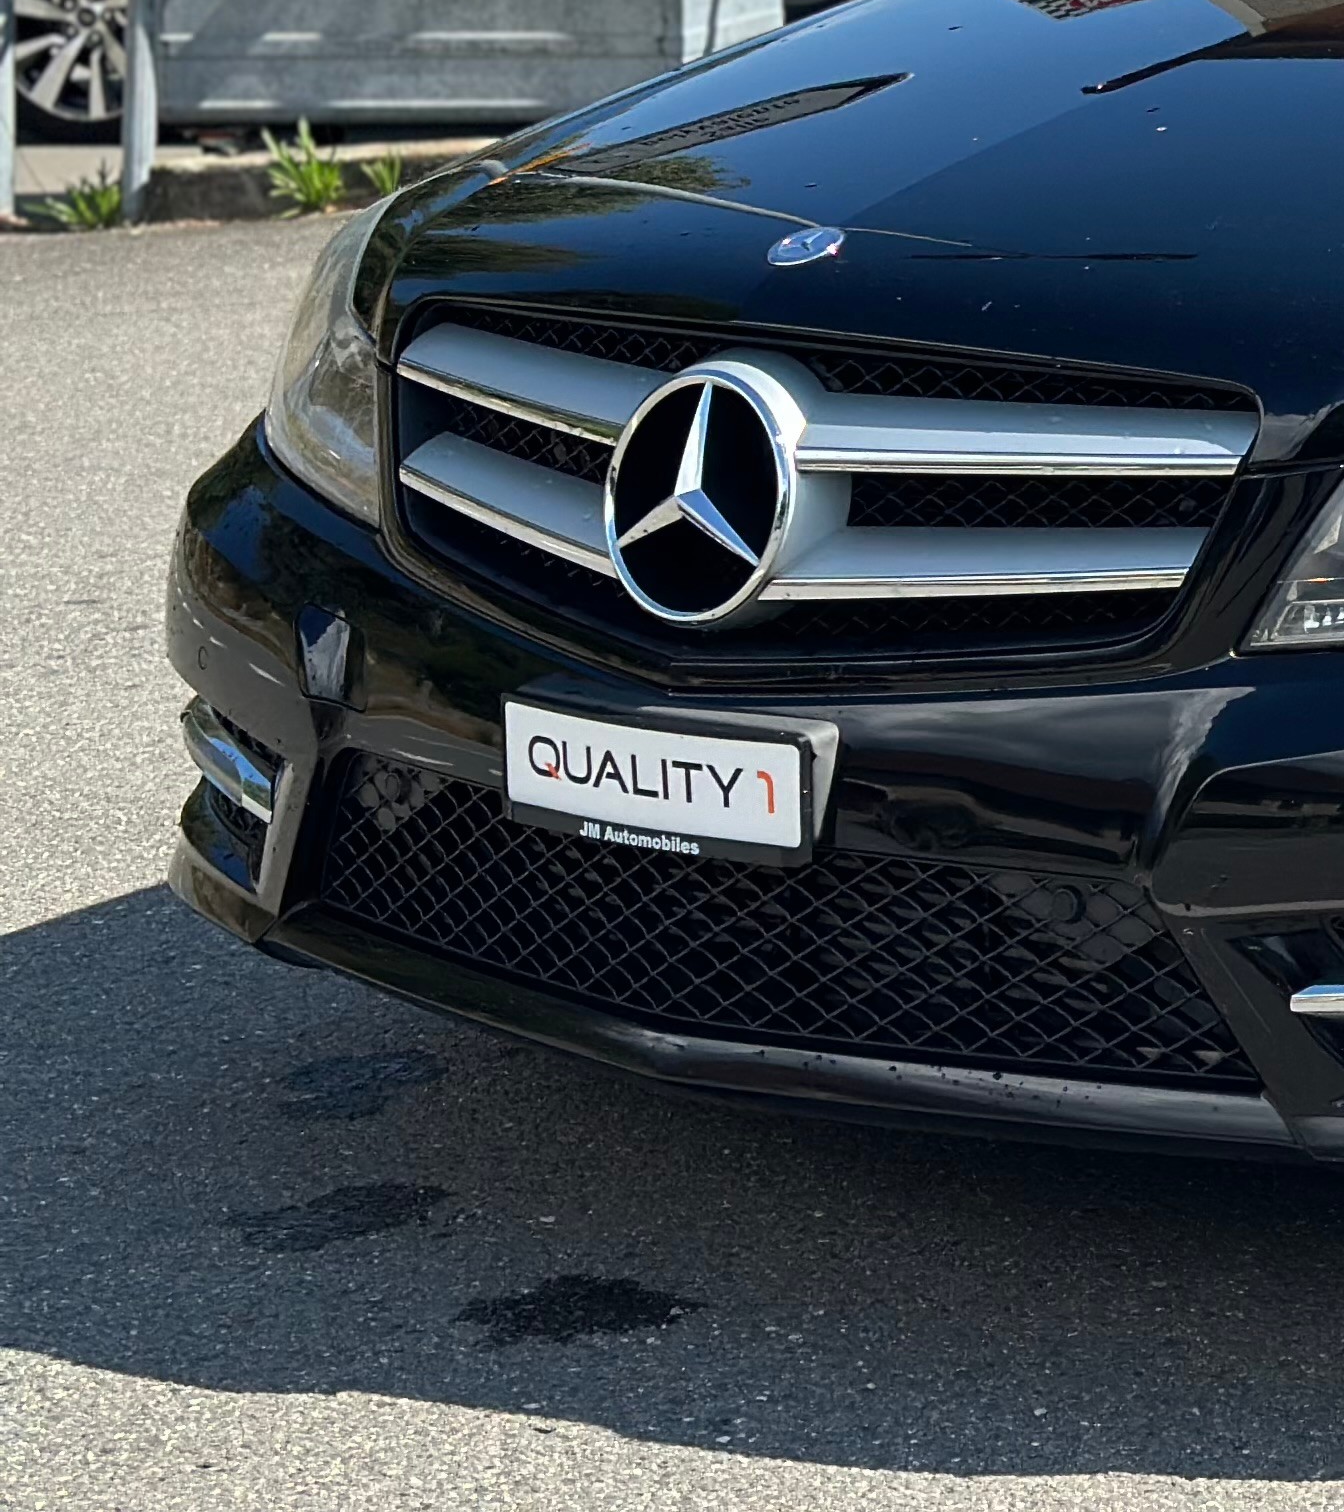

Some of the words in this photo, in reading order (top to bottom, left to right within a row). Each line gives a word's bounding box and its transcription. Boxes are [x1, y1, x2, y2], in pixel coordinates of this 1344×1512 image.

[527, 734, 744, 808] QUALITY
[756, 769, 776, 814] 1
[579, 820, 601, 841] JM
[604, 824, 701, 856] Automobiles
